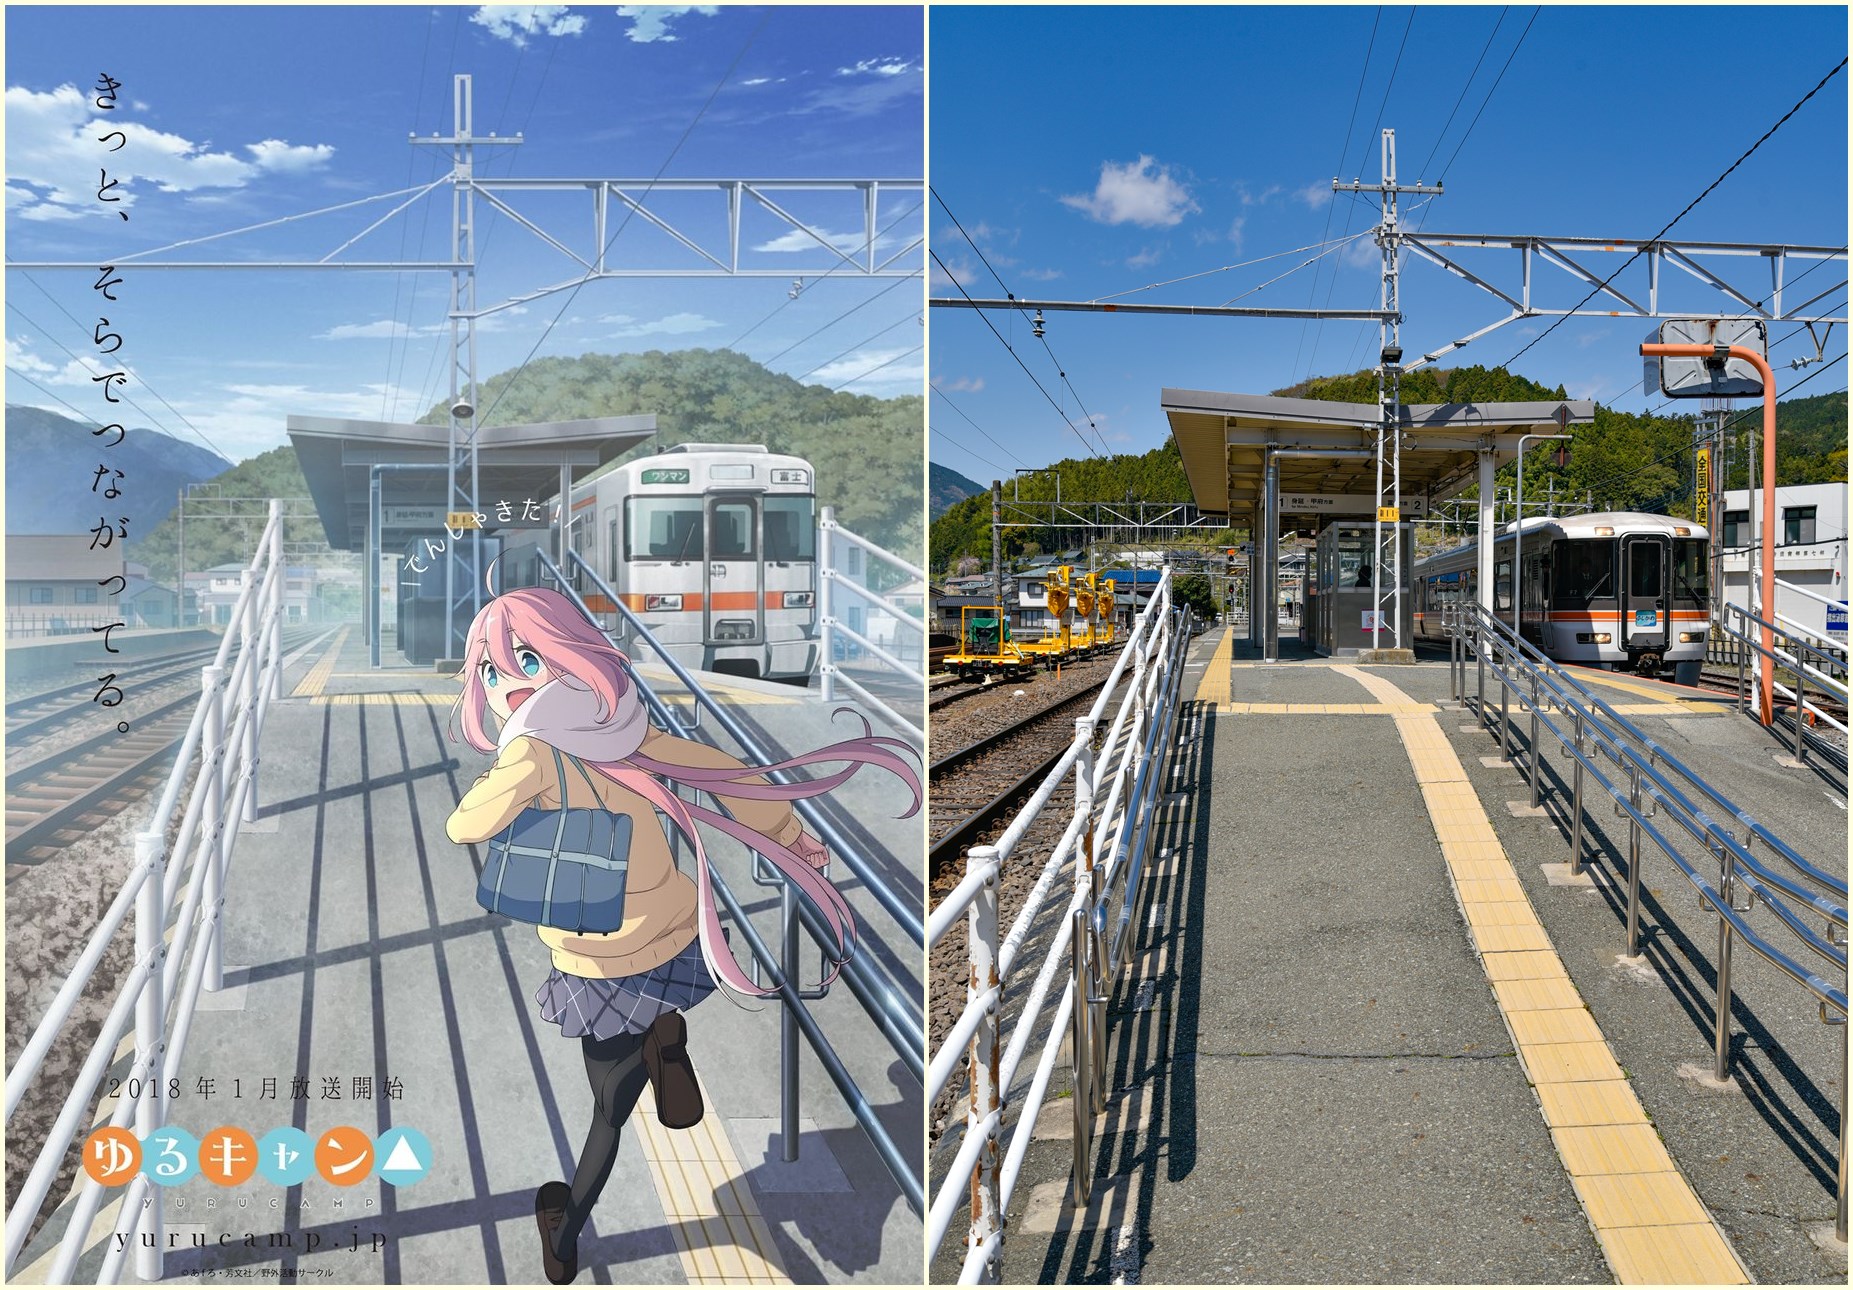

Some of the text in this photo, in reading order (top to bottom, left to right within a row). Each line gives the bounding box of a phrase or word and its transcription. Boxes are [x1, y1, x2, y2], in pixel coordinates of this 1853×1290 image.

[652, 472, 688, 482] ワンマン
[779, 471, 802, 482] 富士
[1698, 455, 1707, 528] 全国交通
[1414, 500, 1421, 510] 2
